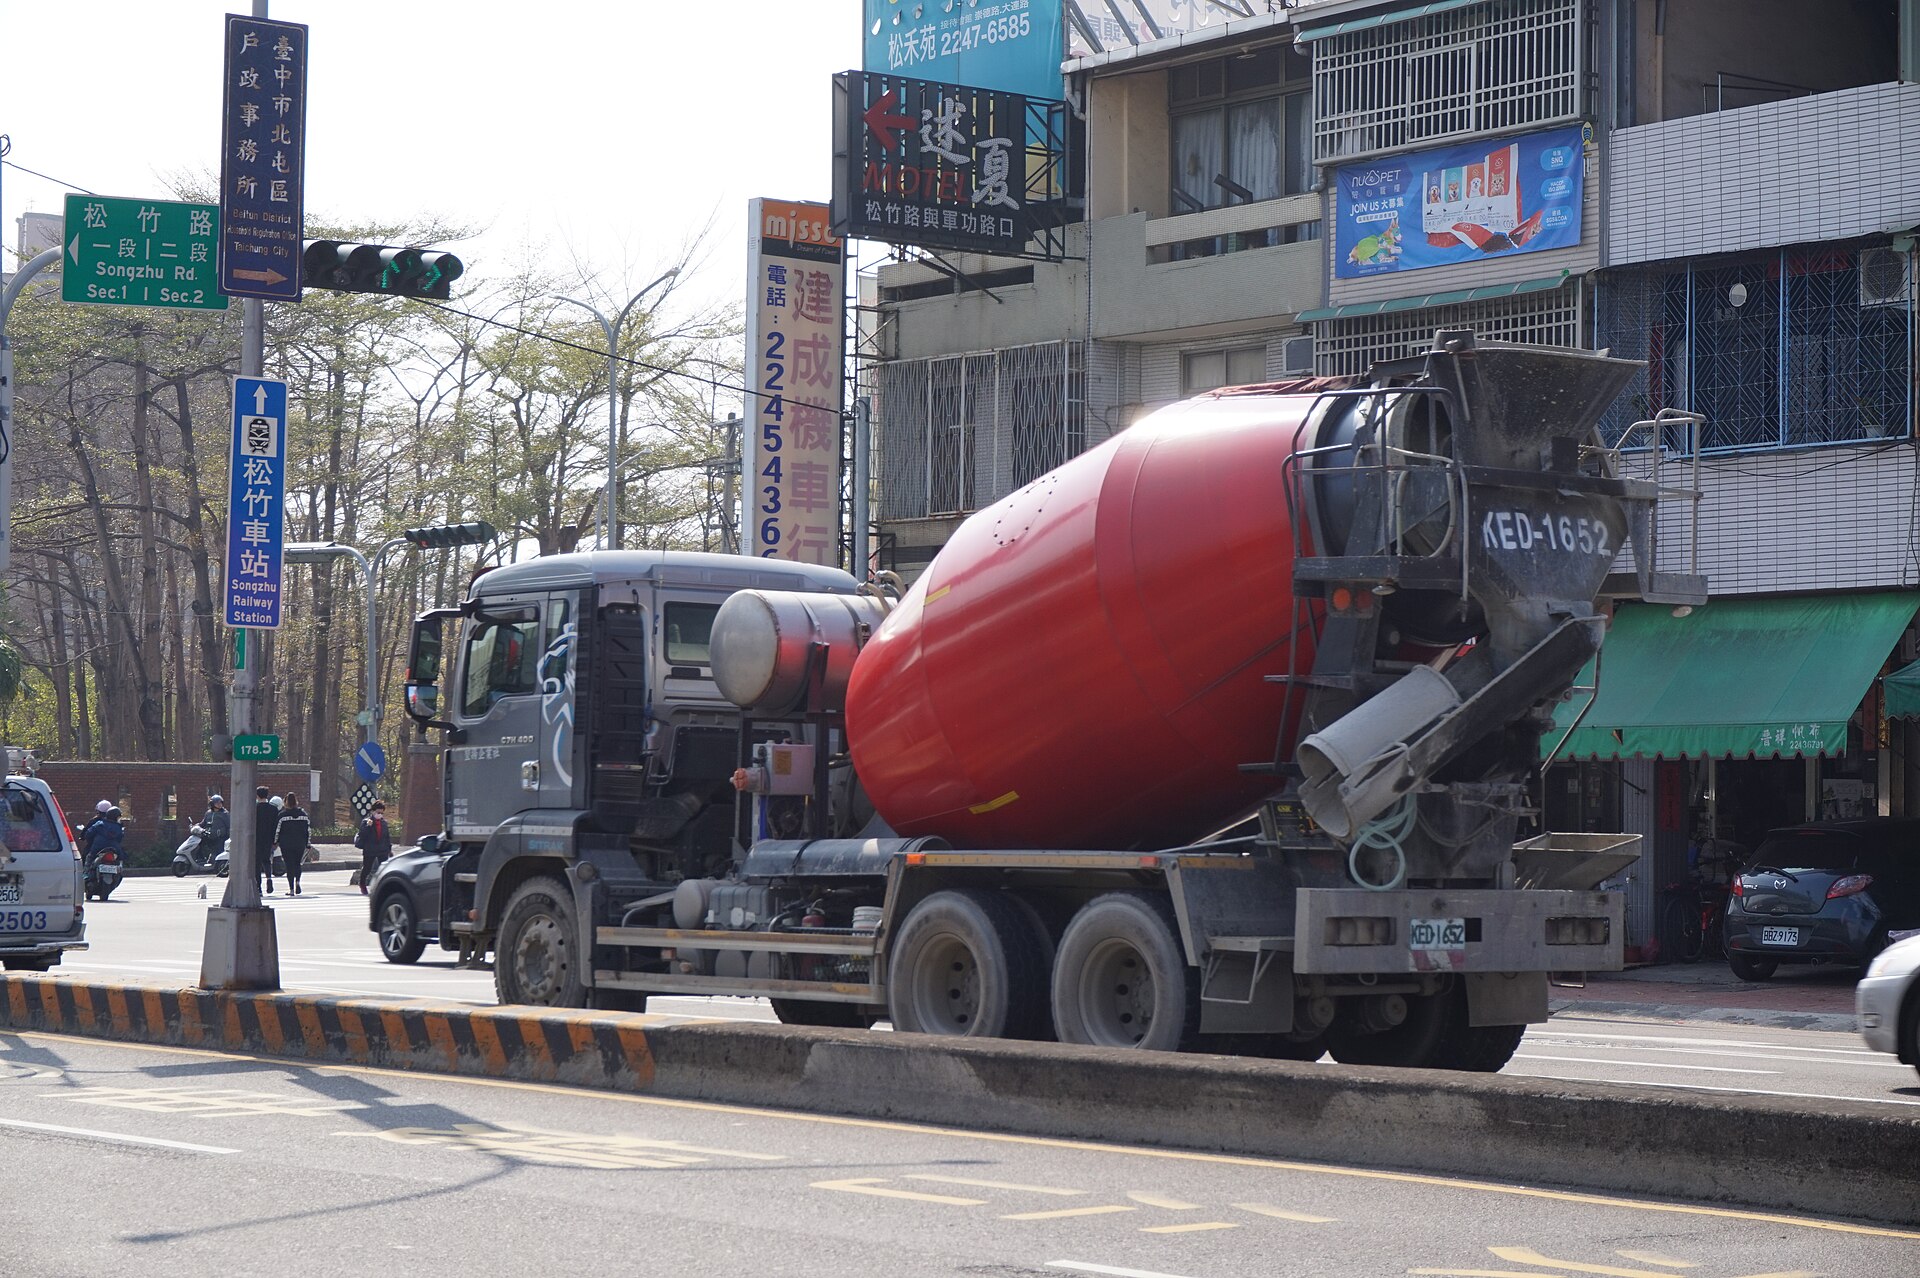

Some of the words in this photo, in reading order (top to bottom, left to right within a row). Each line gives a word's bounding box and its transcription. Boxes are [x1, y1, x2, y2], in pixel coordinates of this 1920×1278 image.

[888, 24, 936, 70] 松禾苑
[941, 12, 1030, 57] 2247-6585
[236, 32, 260, 200] 戶政事務所
[270, 35, 294, 203] 臺中市北屯區
[862, 161, 969, 203] MOTEL
[233, 208, 258, 220] Beitun
[262, 212, 291, 224] District
[1369, 201, 1379, 211] US
[84, 202, 213, 236] 松竹路
[866, 200, 1013, 238] 松竹路與軍功路口
[92, 237, 136, 259] 一段
[160, 242, 208, 263] 二段
[233, 242, 269, 256] Taichung
[272, 246, 289, 258] City
[96, 262, 165, 283] Songzhu
[174, 264, 198, 281] Rd.
[87, 285, 127, 300] Sec.1
[160, 288, 204, 304] Sec.2
[240, 458, 273, 578] 松竹車站
[1482, 511, 1611, 557] KED-1652
[231, 579, 276, 594] Songzhu
[233, 595, 273, 609] Railway
[233, 611, 272, 623] Station
[241, 740, 272, 756] 178.5
[518, 735, 534, 743] 400
[1411, 924, 1464, 945] KED-1652
